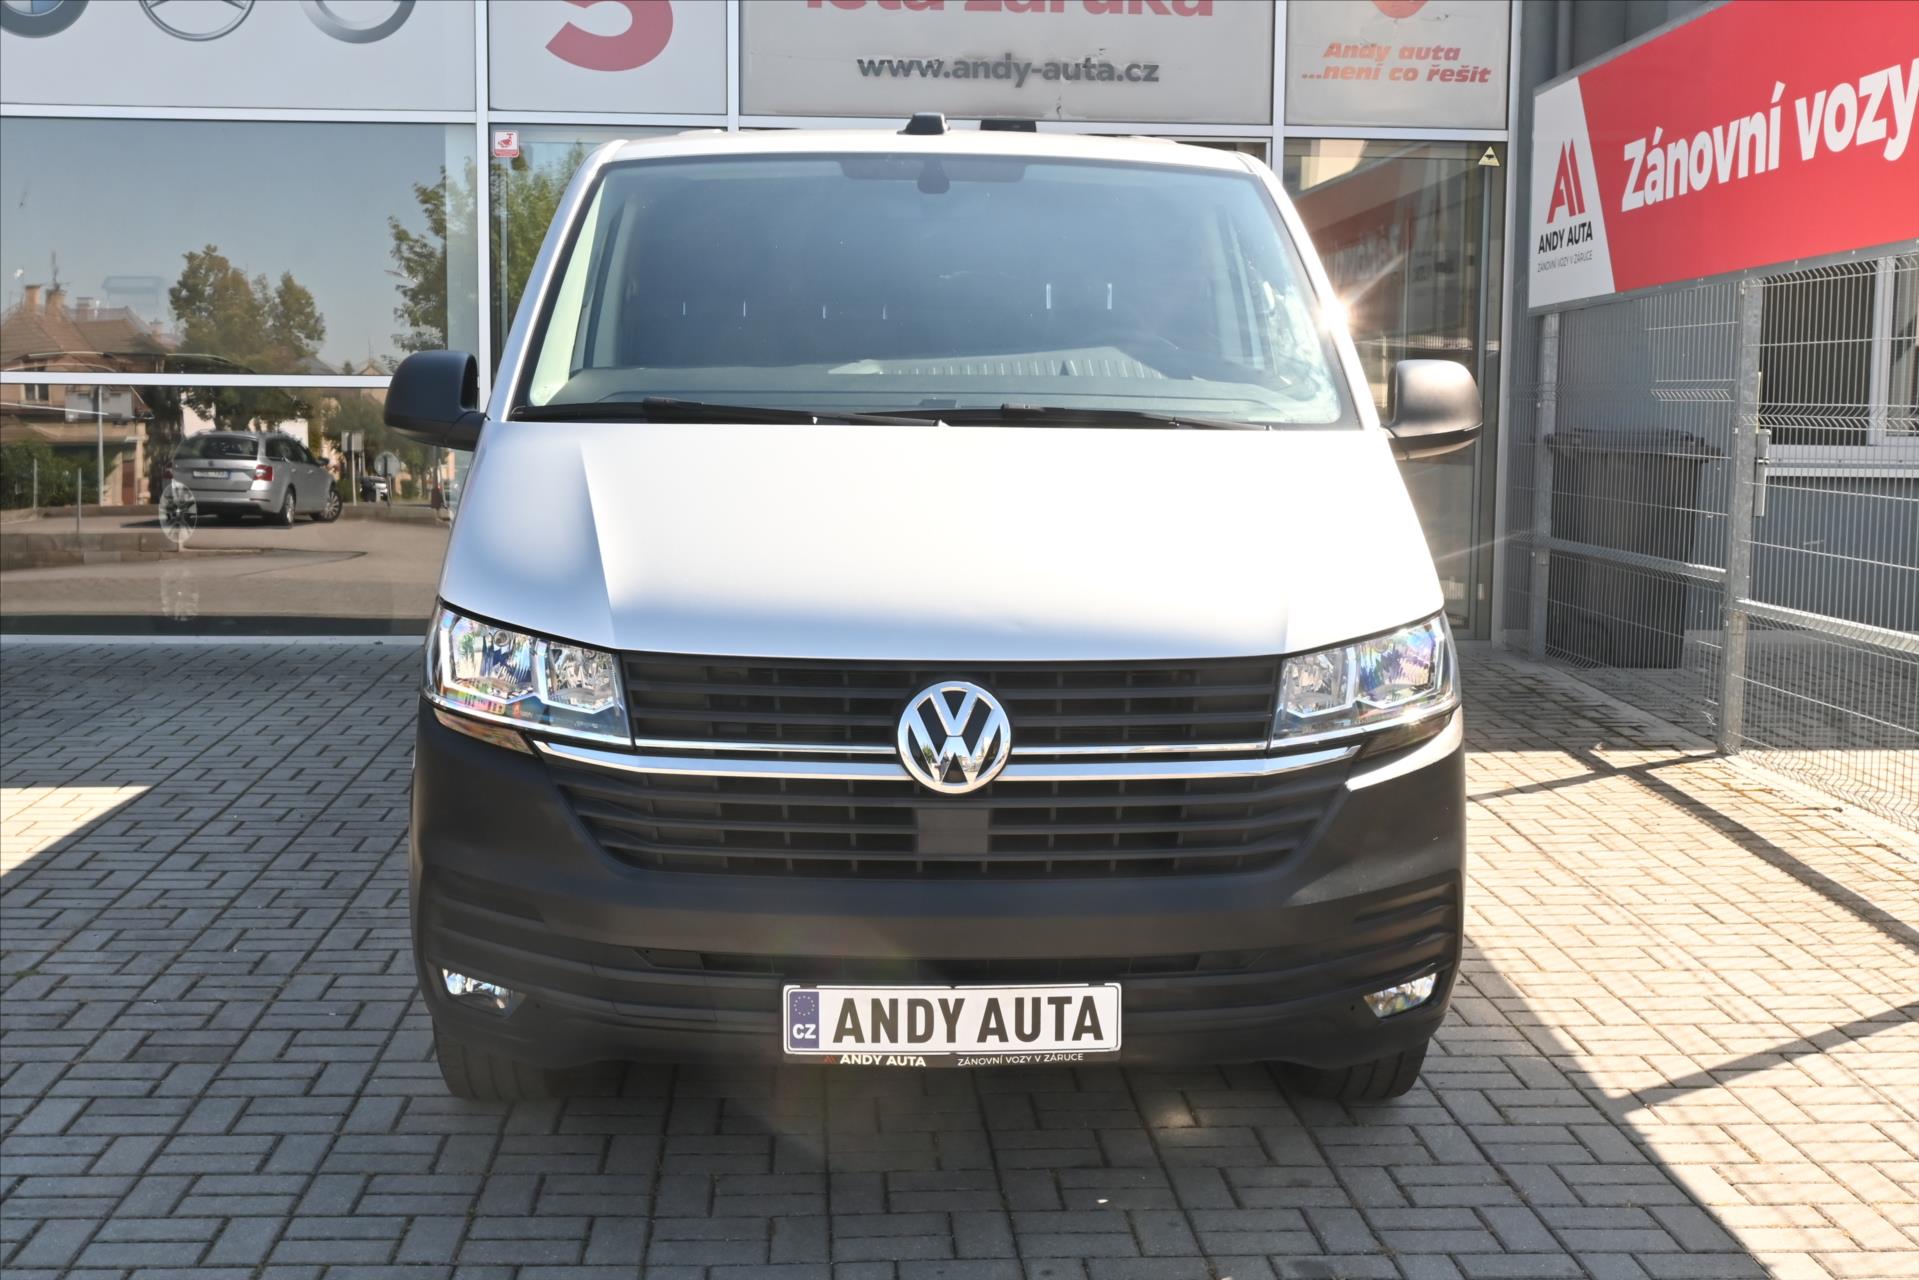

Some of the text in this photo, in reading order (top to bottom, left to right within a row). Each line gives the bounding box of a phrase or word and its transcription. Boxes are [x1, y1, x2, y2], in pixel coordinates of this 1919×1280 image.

[1323, 42, 1461, 62] Andy auta
[856, 53, 1160, 88] www.andy-auta.cz
[1388, 66, 1419, 82] co
[1426, 64, 1492, 83] řešit
[1621, 57, 1919, 212] Zánovní vozy
[1538, 220, 1593, 254] ANDY AUTA
[832, 995, 1104, 1044] ANDY AUTA
[792, 1023, 817, 1040] CZ
[839, 1053, 927, 1067] ANDY AUTA
[957, 1052, 1084, 1067] ZÁNOVNÍ VOZY V ZÁRUCE
